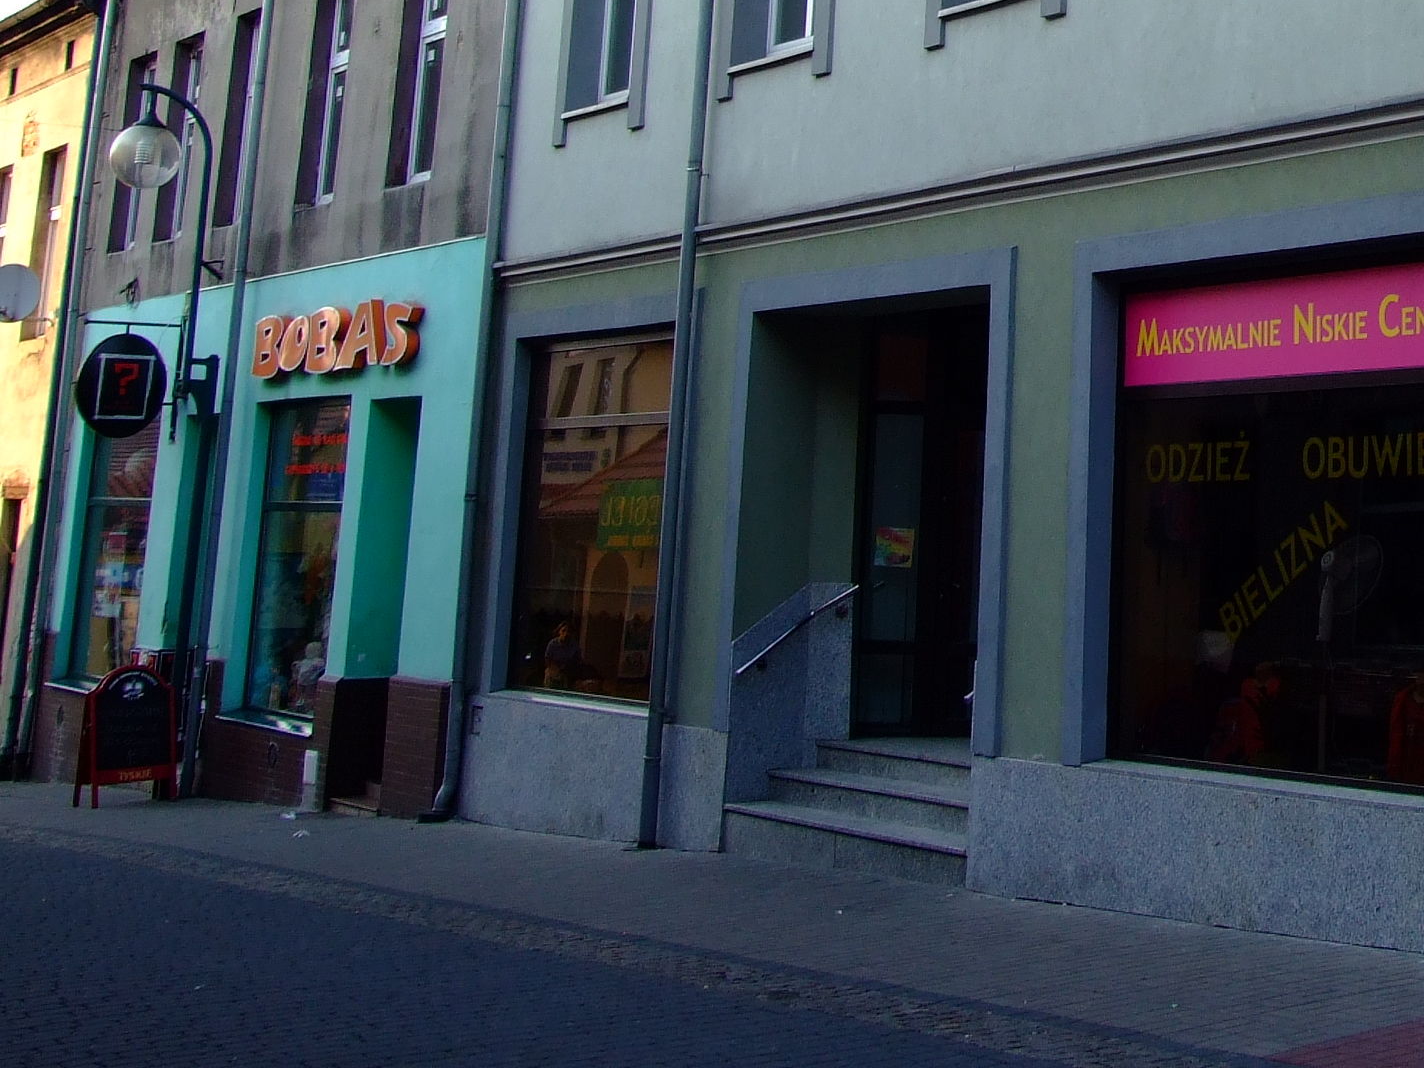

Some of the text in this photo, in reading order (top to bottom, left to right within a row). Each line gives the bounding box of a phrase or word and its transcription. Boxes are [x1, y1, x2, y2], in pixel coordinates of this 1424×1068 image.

[252, 299, 420, 379] BOBAS
[1146, 431, 1250, 482] ODZIEŻ
[1218, 500, 1349, 645] BIELIZNA
